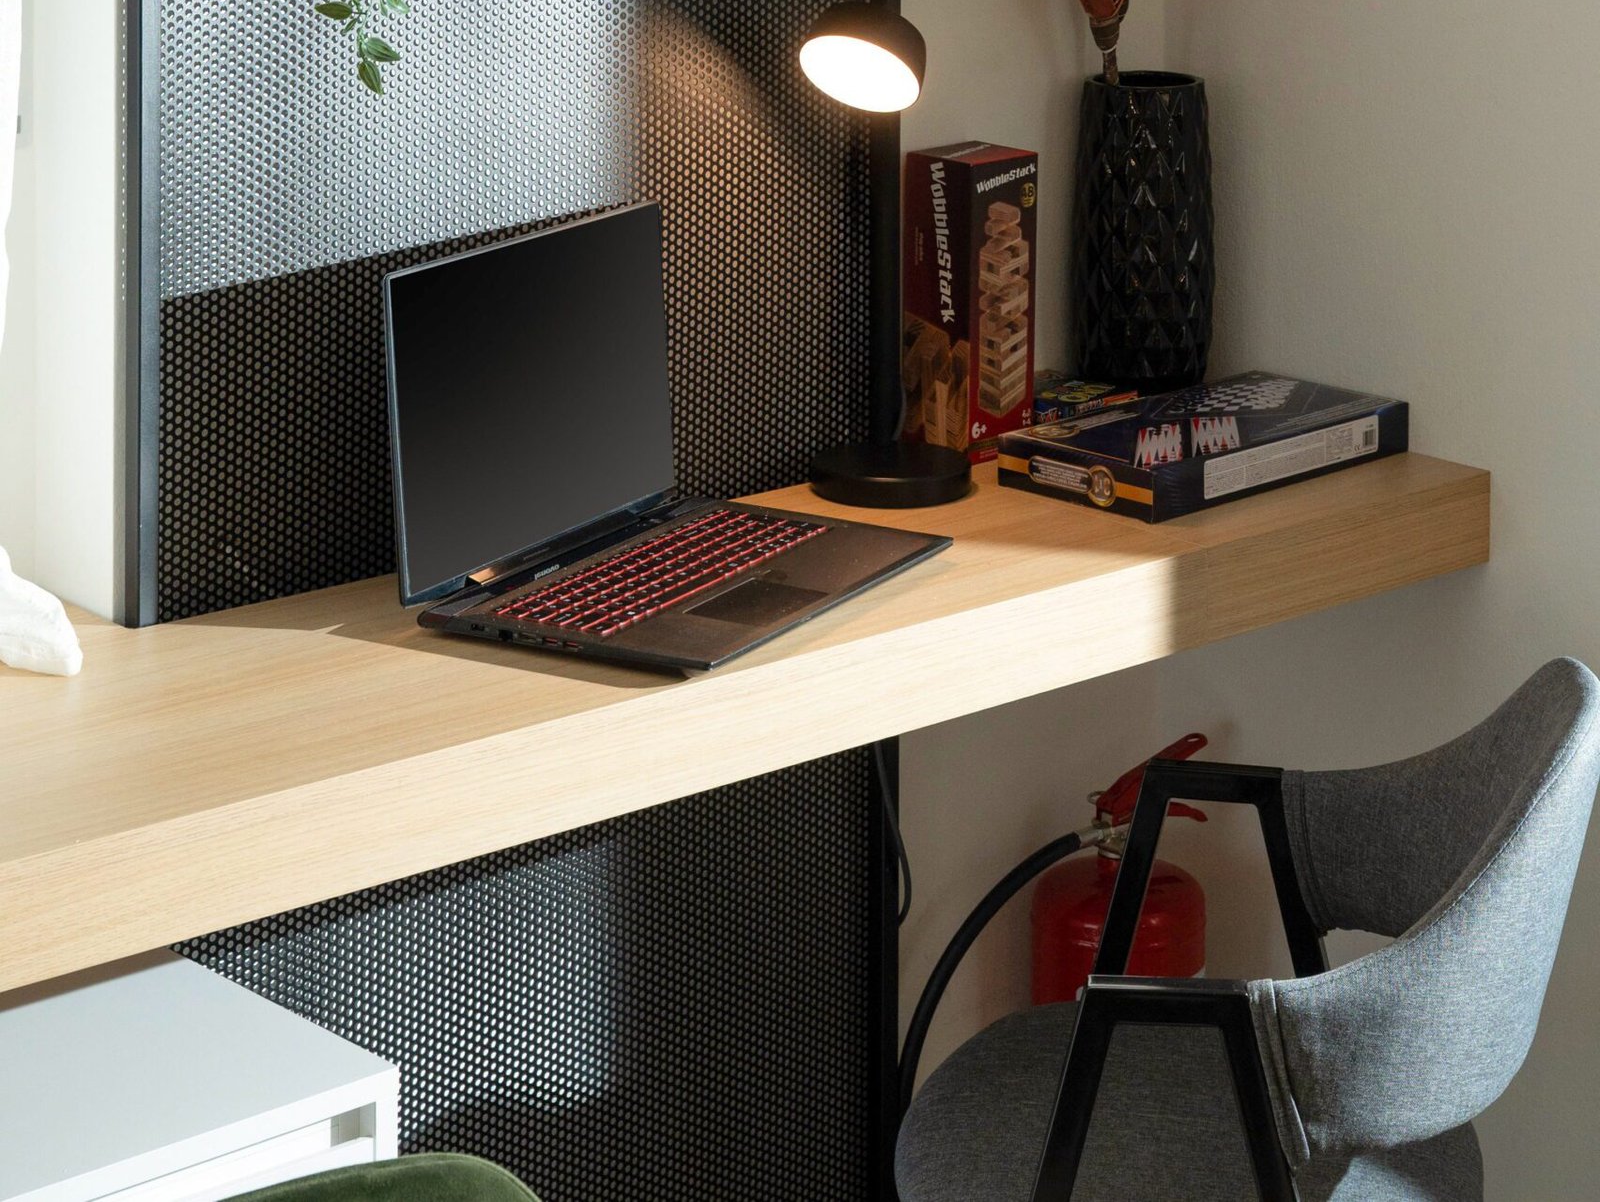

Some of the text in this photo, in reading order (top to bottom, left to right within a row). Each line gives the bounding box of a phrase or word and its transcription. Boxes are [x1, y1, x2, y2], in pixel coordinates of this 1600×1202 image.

[976, 162, 1036, 194] WobbleStack
[929, 161, 956, 323] WobbleStack
[971, 421, 987, 439] 6+
